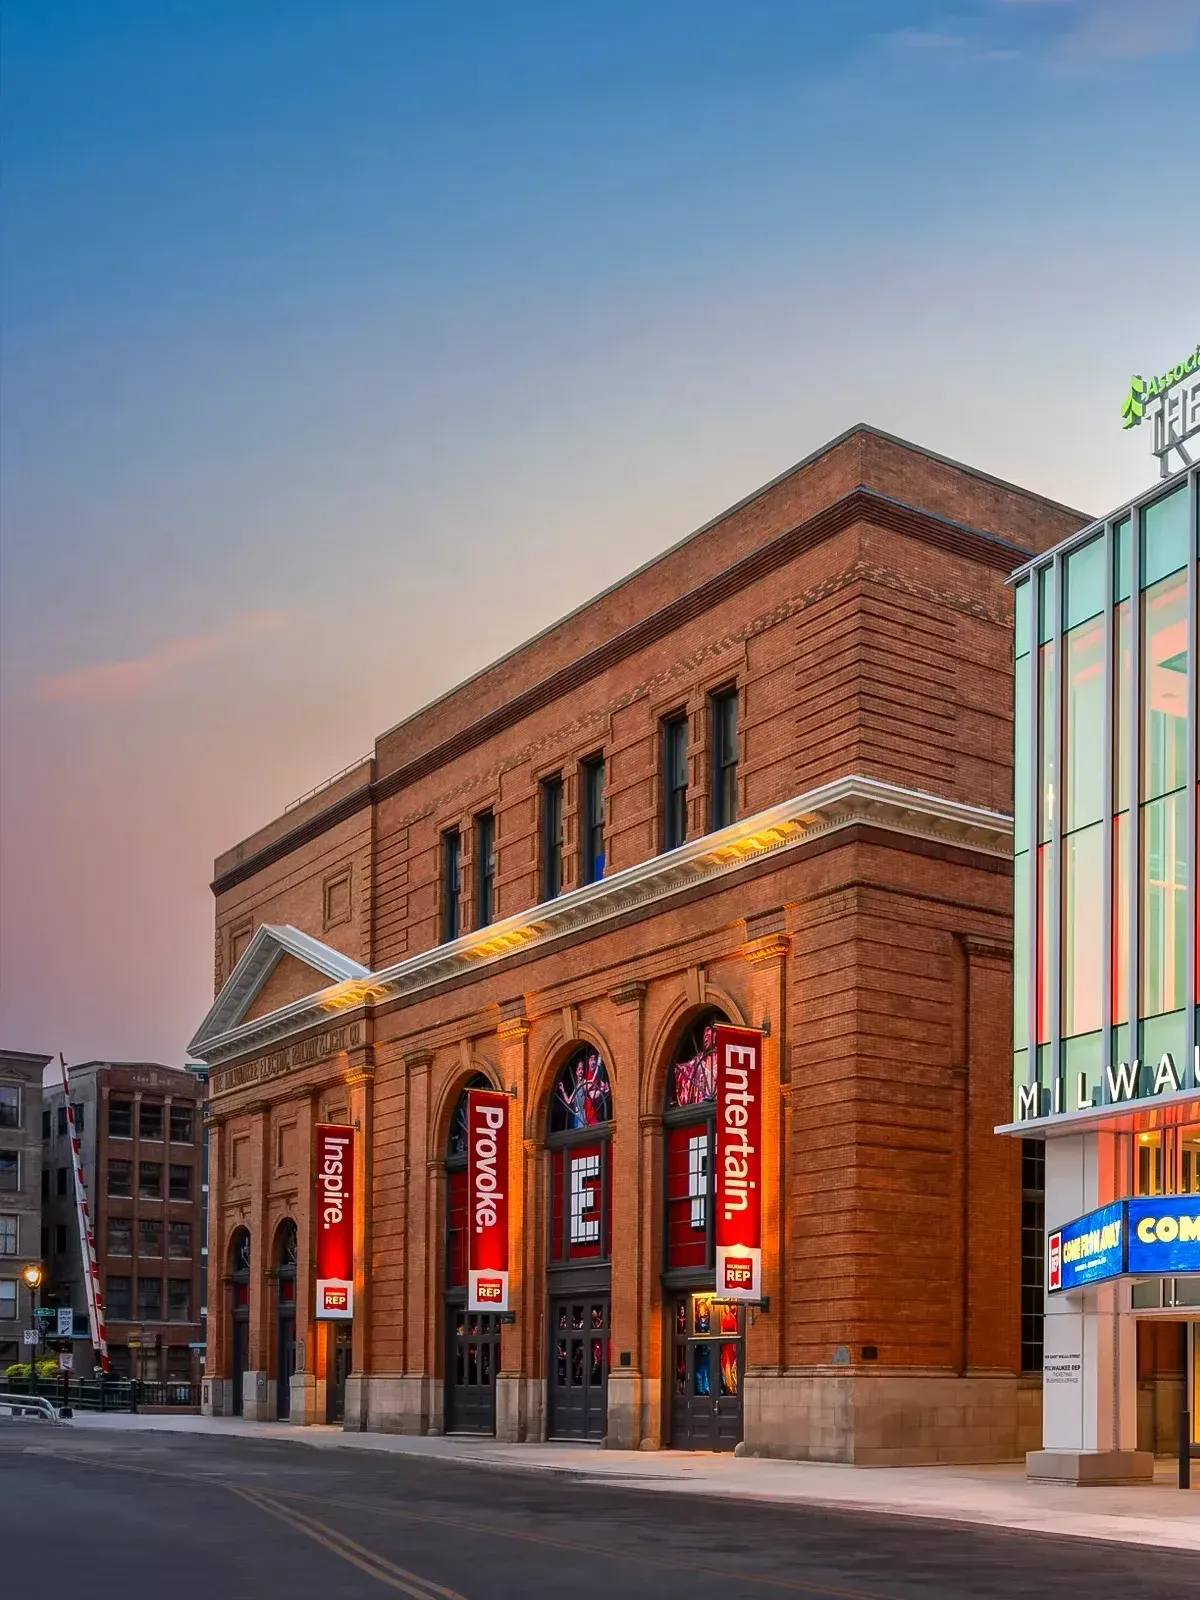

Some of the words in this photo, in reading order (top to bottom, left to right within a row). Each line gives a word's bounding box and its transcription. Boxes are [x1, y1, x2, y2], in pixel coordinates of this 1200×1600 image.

[725, 1044, 756, 1221] Entertain.
[319, 1136, 350, 1230] Inspire.
[475, 1105, 504, 1234] Provoke.
[1063, 1236, 1081, 1264] COME
[726, 1269, 751, 1282] REP
[325, 1295, 346, 1305] REP
[478, 1287, 501, 1297] REP
